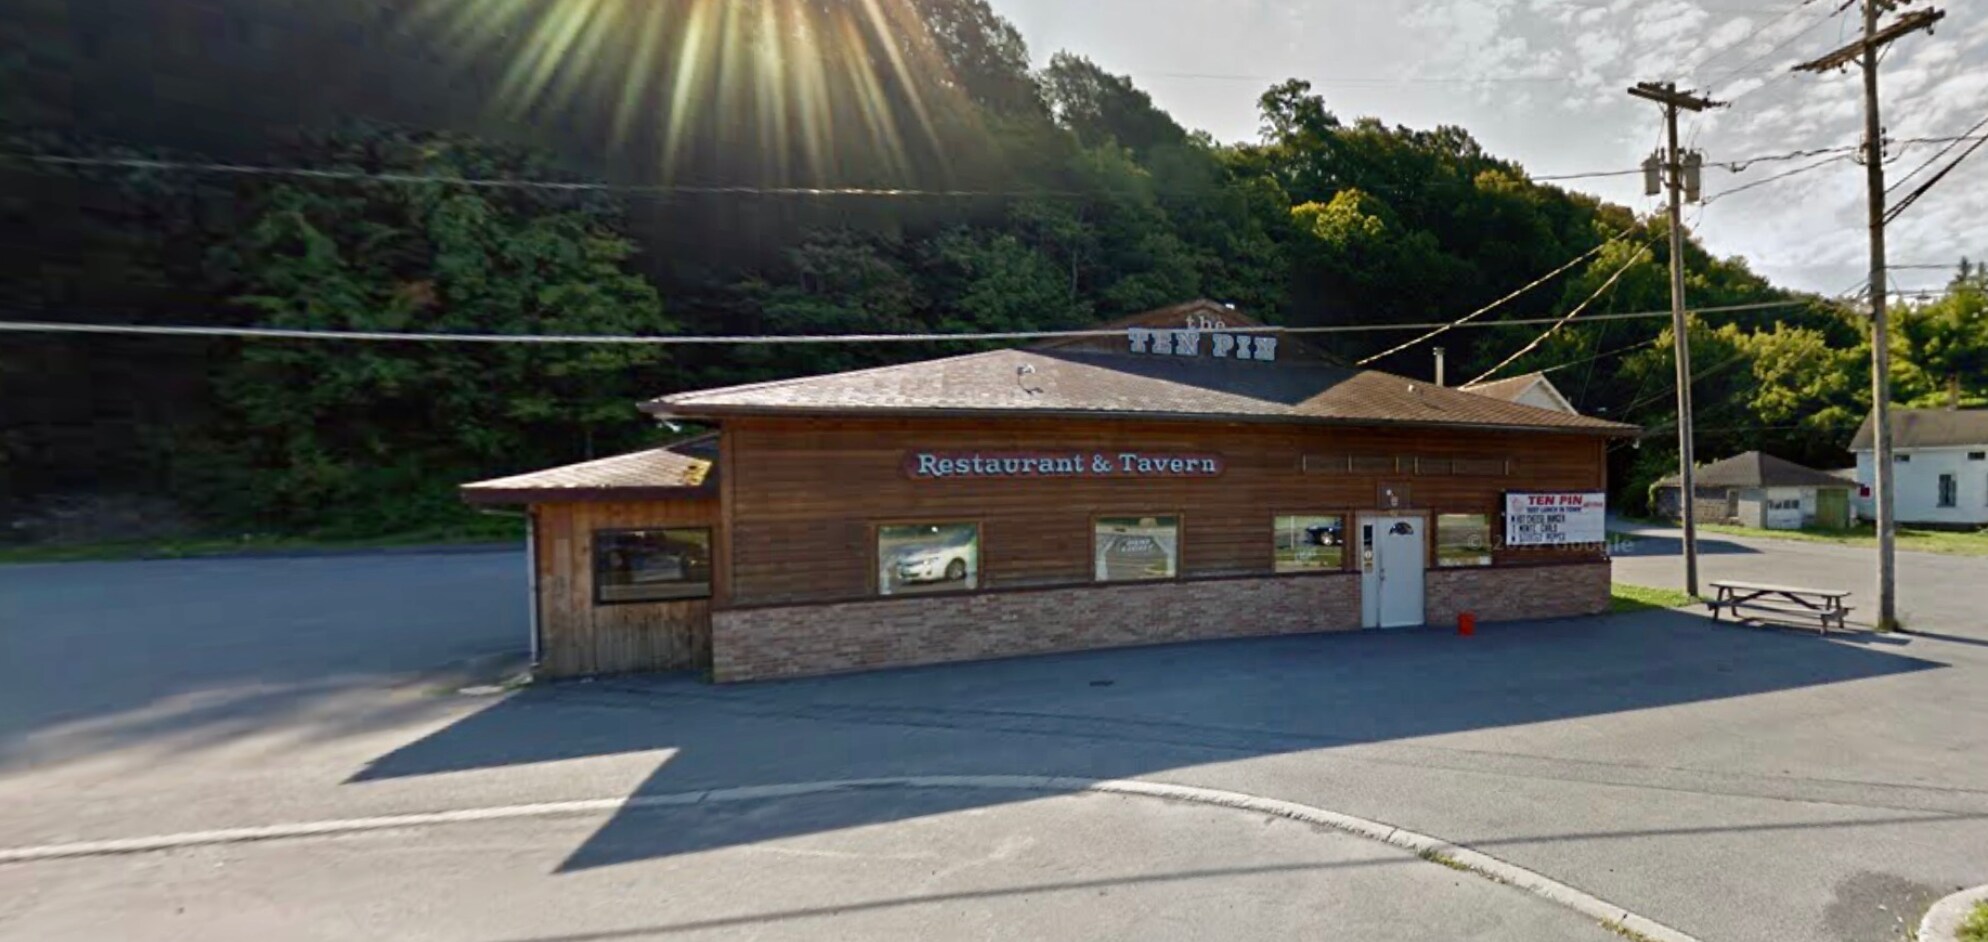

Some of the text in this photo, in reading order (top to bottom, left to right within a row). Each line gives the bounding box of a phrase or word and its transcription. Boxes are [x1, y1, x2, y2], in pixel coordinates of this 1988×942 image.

[1186, 315, 1226, 330] the
[1128, 328, 1277, 360] TEN PIN
[917, 452, 1216, 475] Restaurant & Tavern
[1528, 496, 1555, 505] TEN
[1559, 496, 1583, 505] PIN
